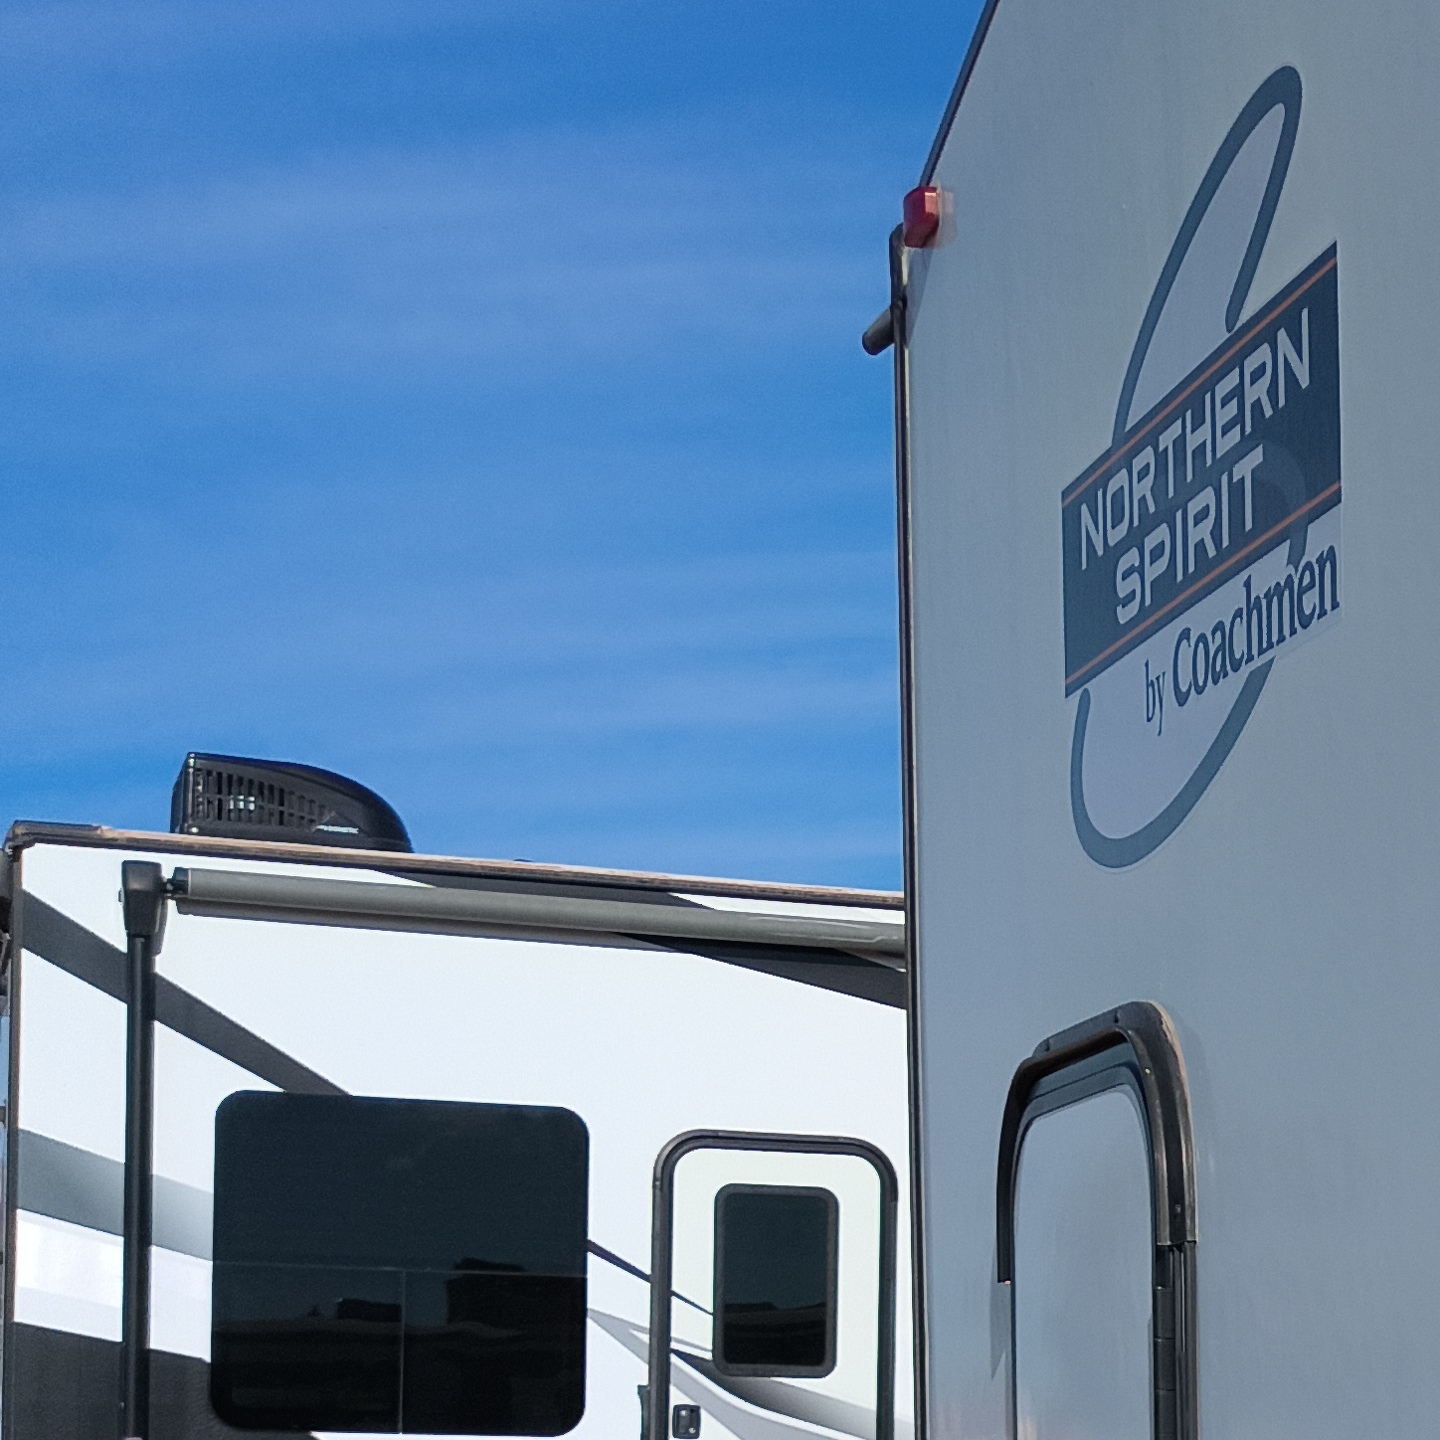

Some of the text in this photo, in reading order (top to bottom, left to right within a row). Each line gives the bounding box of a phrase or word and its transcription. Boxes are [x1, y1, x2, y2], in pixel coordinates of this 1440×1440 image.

[1081, 307, 1310, 570] NORTHERN
[1115, 444, 1265, 625] SPIRIT
[1144, 543, 1340, 736] by Coachmen
